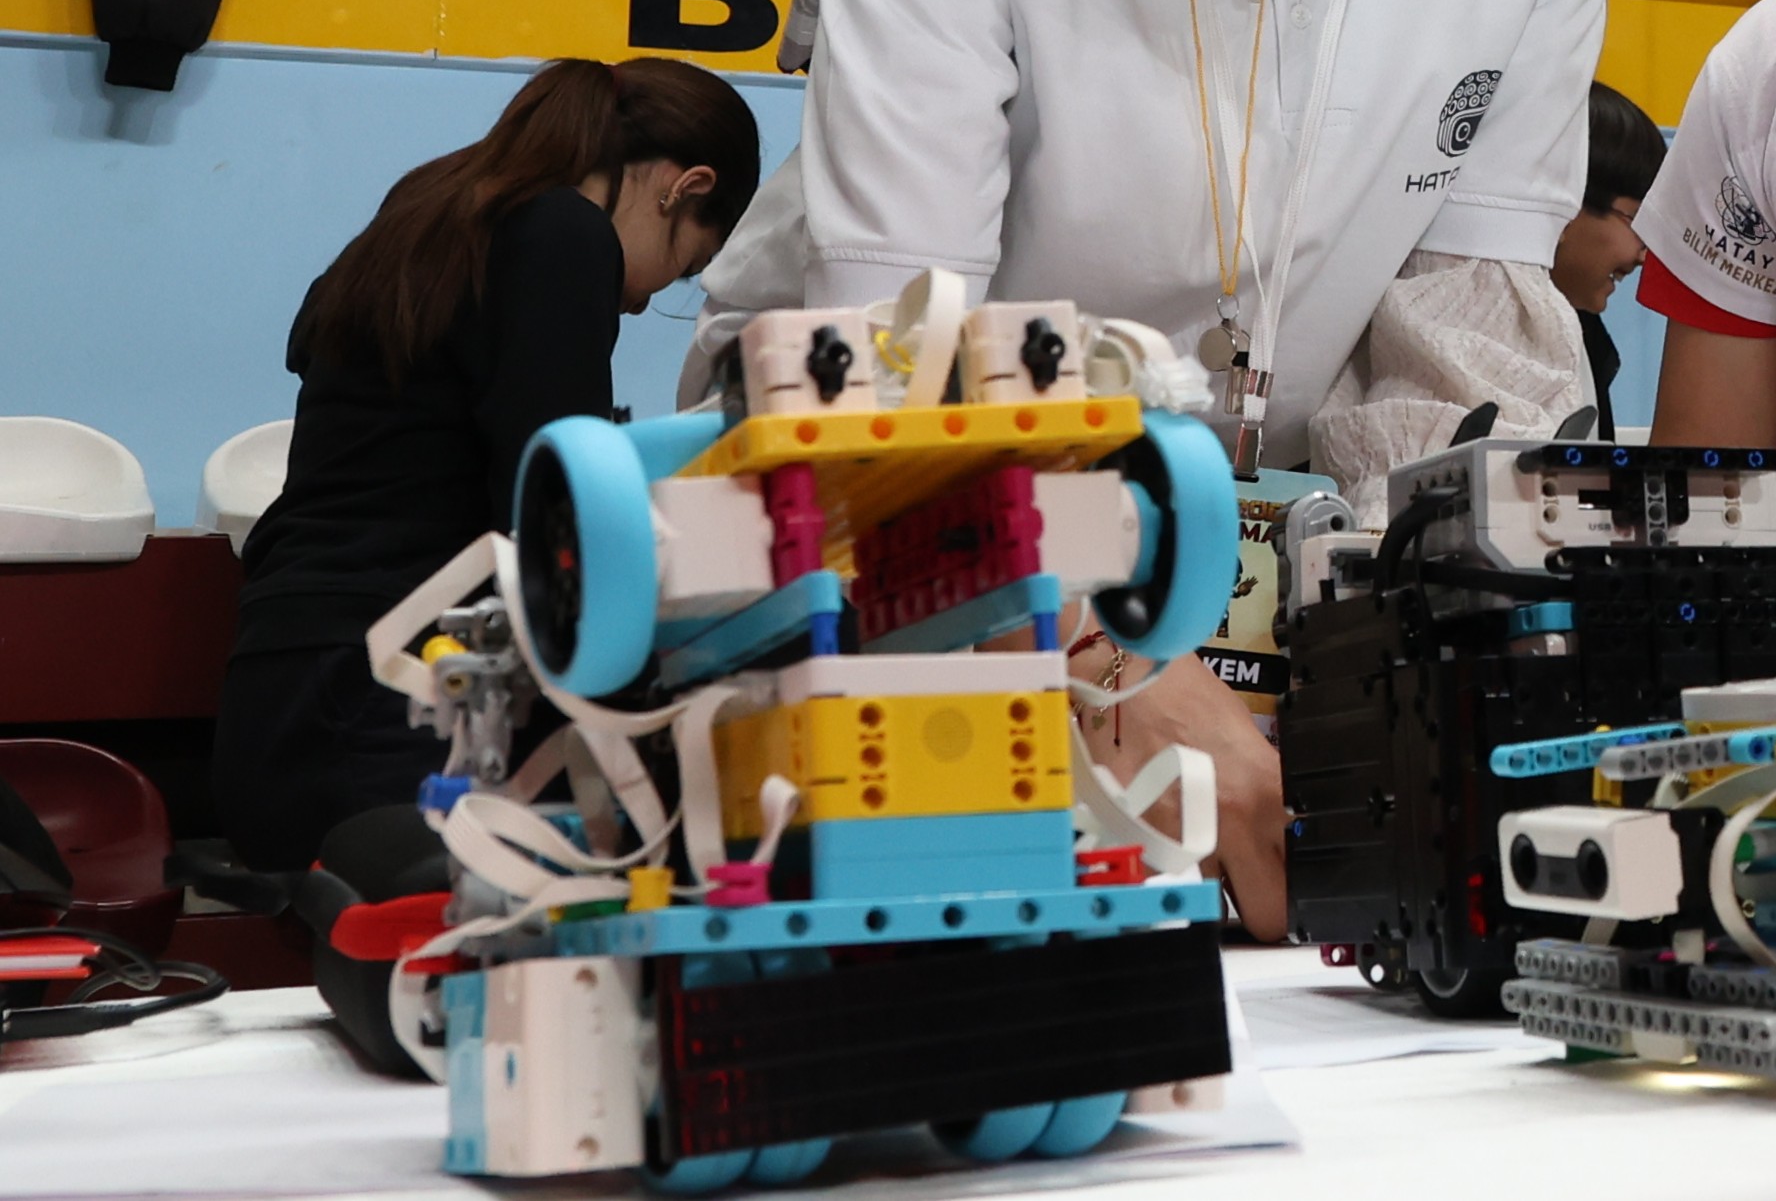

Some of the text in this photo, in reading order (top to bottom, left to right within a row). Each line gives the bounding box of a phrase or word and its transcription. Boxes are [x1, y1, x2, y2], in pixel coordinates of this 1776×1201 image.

[1405, 165, 1461, 193] HATA
[1705, 224, 1774, 269] HATAY
[1203, 656, 1261, 685] KEM
